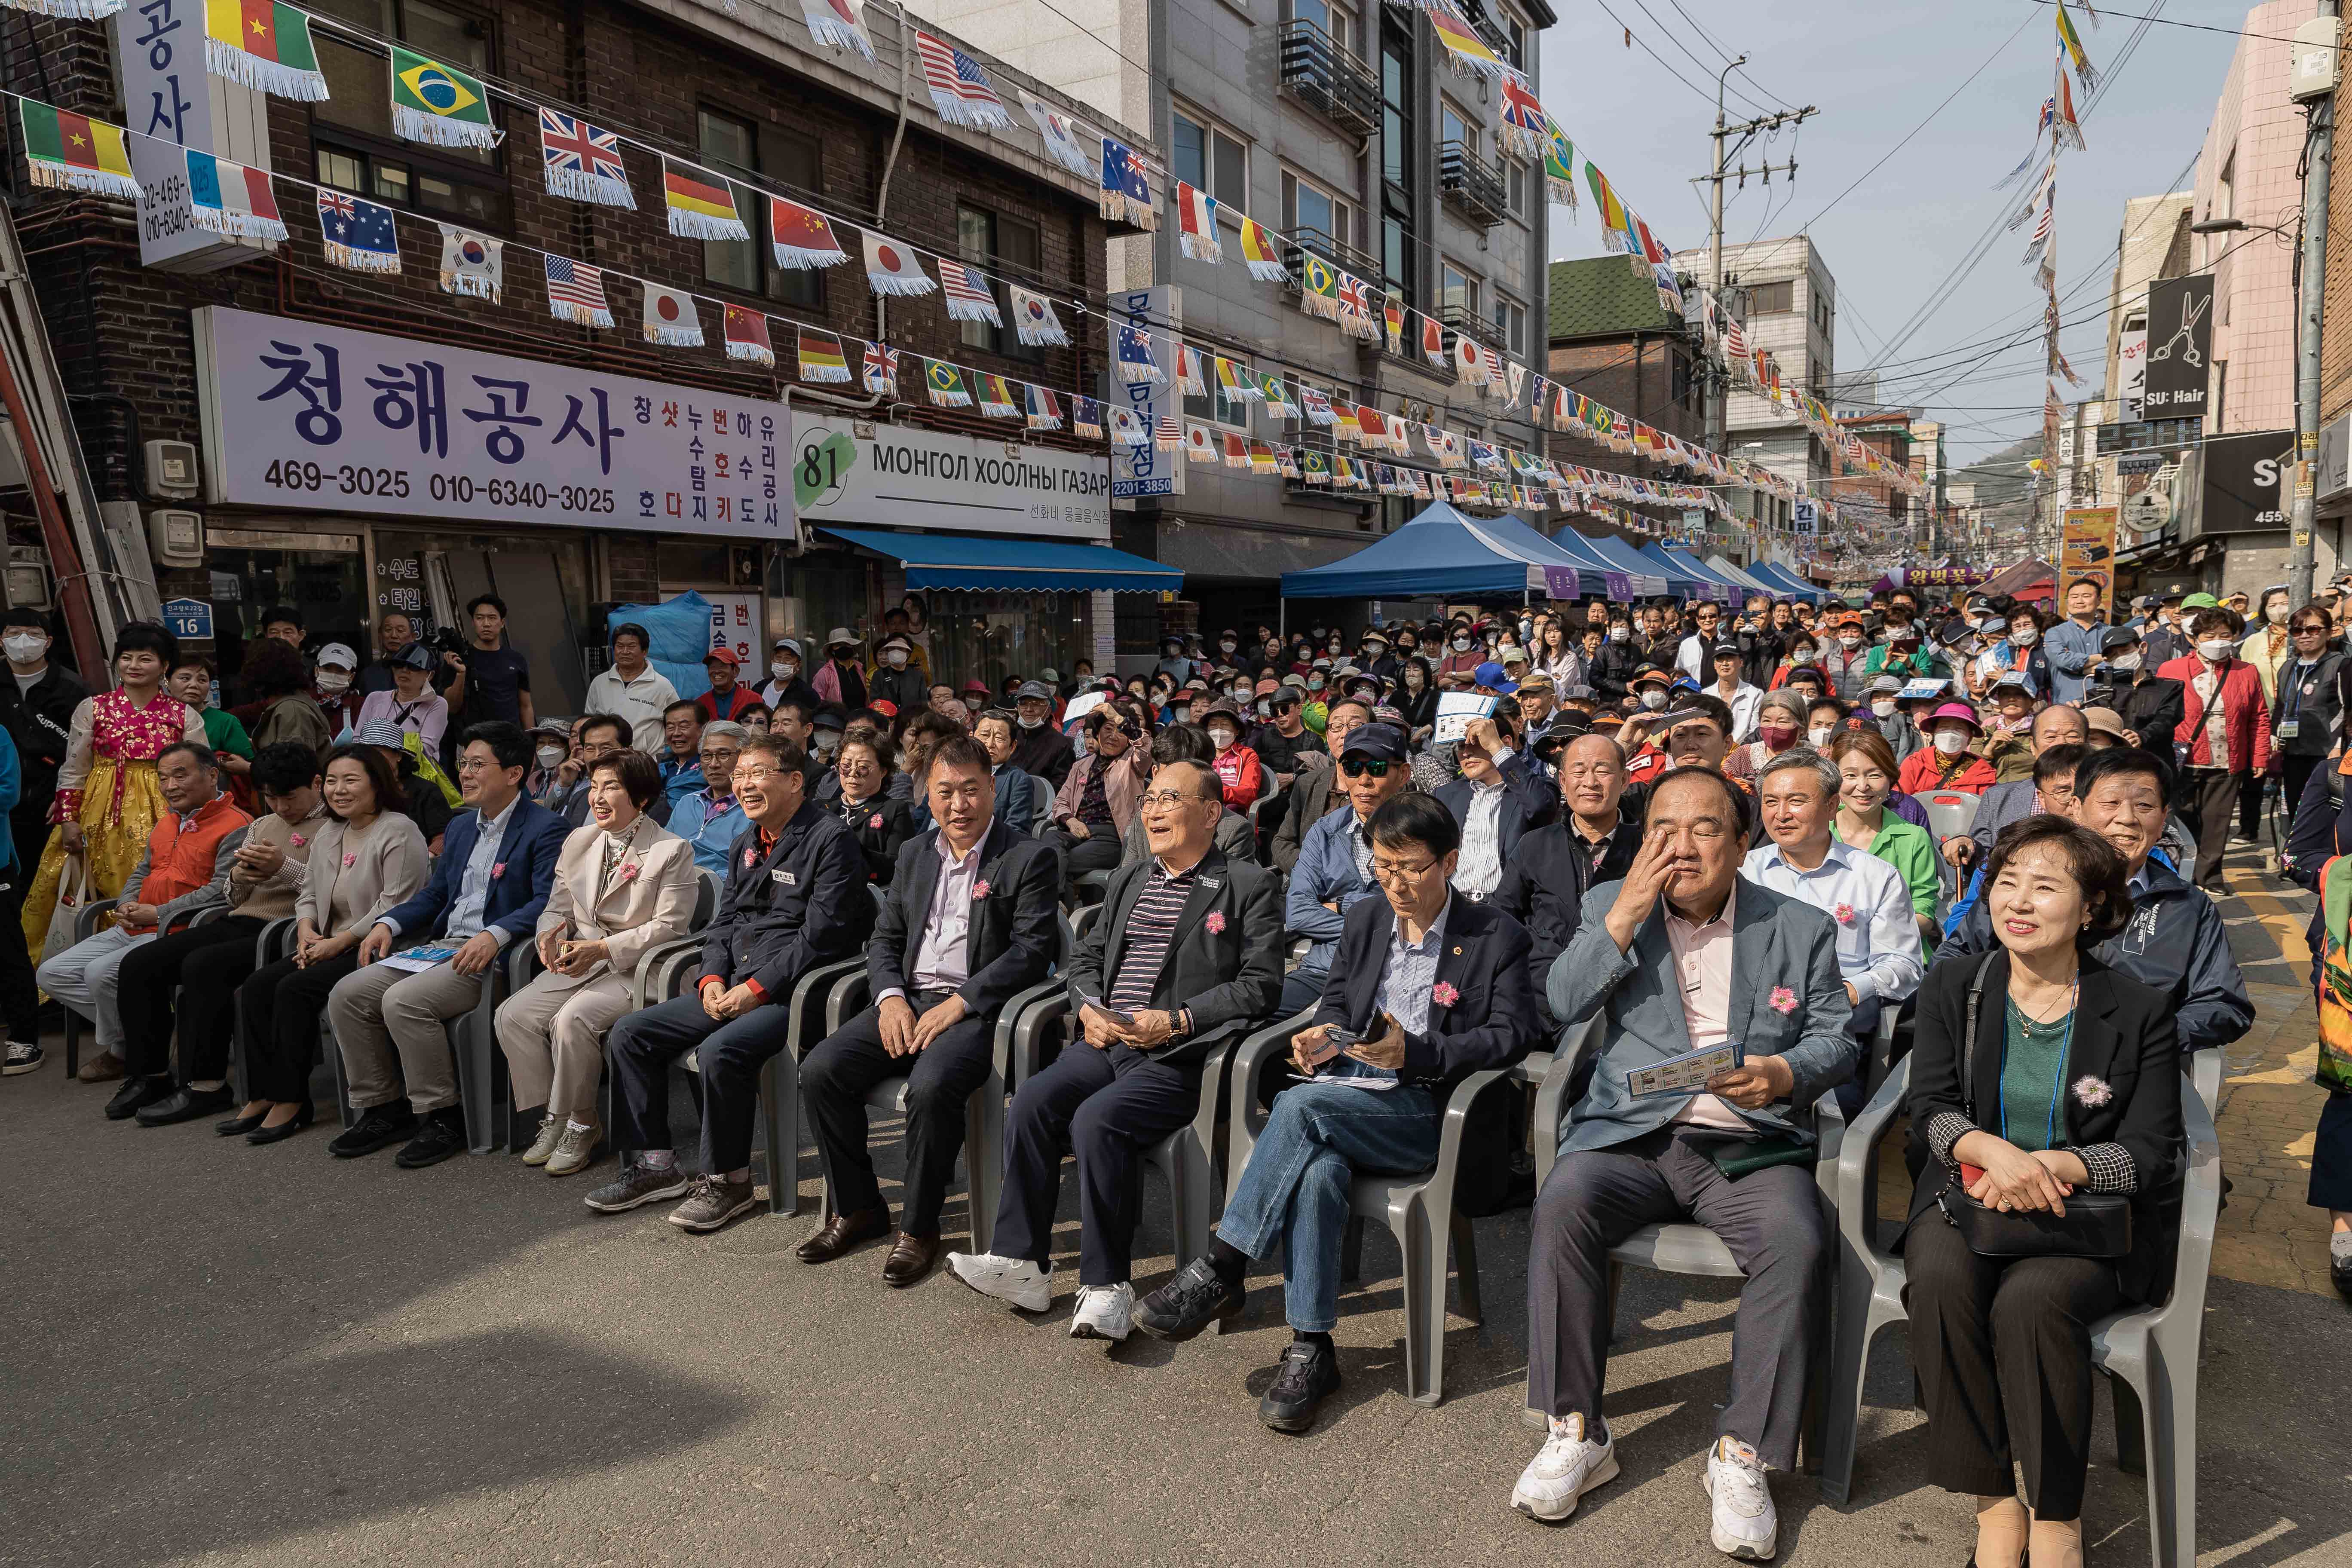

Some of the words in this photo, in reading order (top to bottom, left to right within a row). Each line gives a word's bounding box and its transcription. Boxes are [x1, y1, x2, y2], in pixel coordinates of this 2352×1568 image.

[143, 165, 209, 211] 02-469-025
[257, 340, 625, 475] 청해공사
[2146, 392, 2170, 406] SU:
[2173, 389, 2205, 404] Hair
[634, 395, 656, 518] 창호
[688, 404, 707, 522] 누수탐지
[713, 408, 732, 523] 번호키
[737, 412, 756, 523] 하수도
[760, 415, 779, 527] 유리공사
[803, 444, 840, 490] 81
[873, 443, 969, 481] МОНГОЛ
[974, 456, 1057, 491] ХООЛНЫ
[1062, 470, 1109, 497] ГАЗАР
[264, 459, 410, 498] 469-3025
[430, 473, 615, 514] 010-6340-3025
[1114, 478, 1171, 495] 2201-3850
[1029, 503, 1060, 521] 선화네
[1064, 507, 1110, 526] 몽골음식점
[390, 559, 419, 580] 수도
[392, 588, 421, 610] 타일
[176, 619, 198, 633] 16
[36, 714, 69, 740] Suprem
